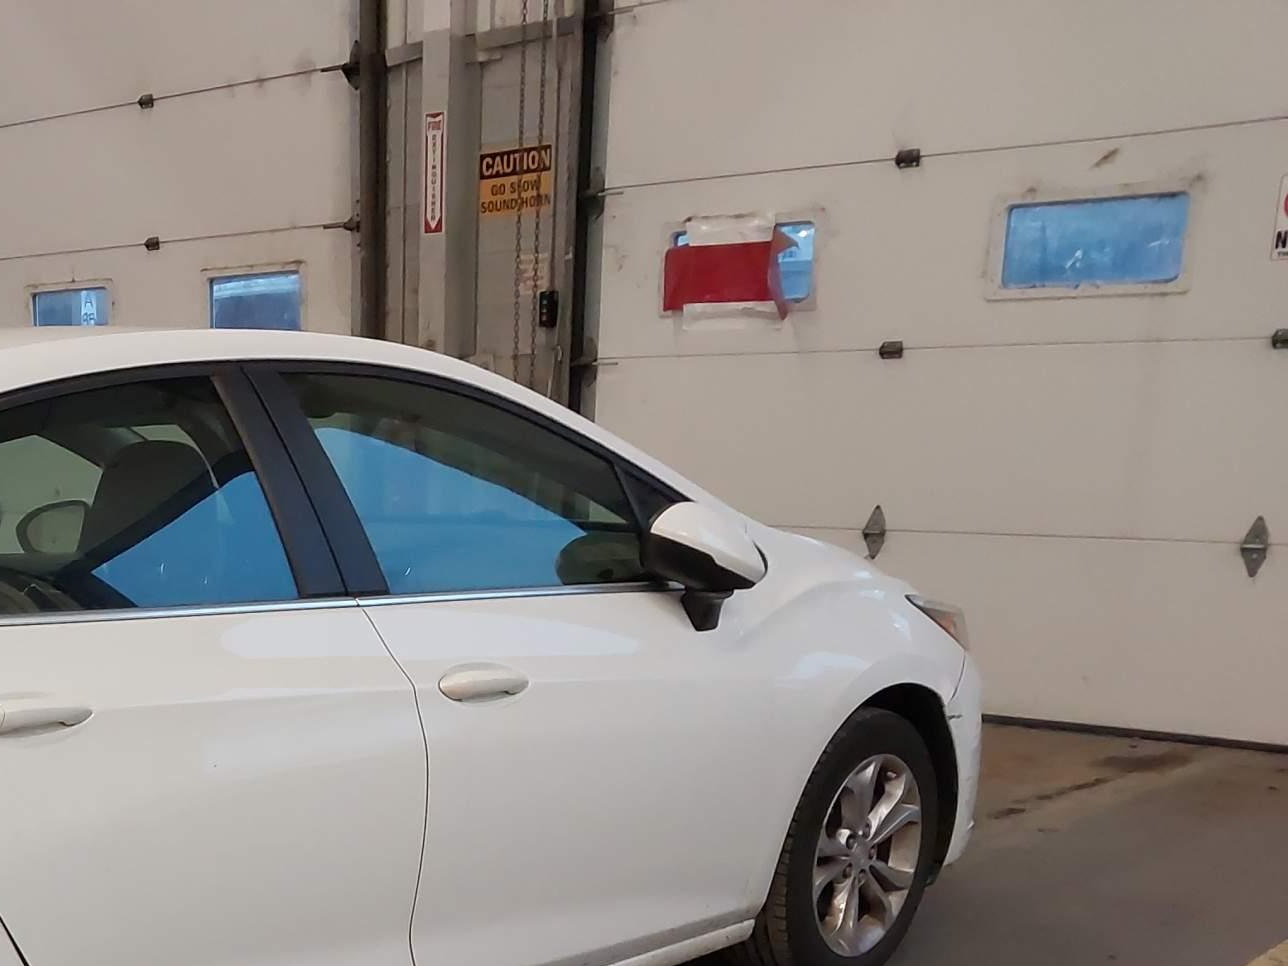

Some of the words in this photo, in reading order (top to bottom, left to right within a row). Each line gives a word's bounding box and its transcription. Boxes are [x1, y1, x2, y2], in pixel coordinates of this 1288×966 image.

[482, 148, 550, 176] CAUTION
[490, 183, 506, 197] GO
[480, 198, 518, 214] SOUND
